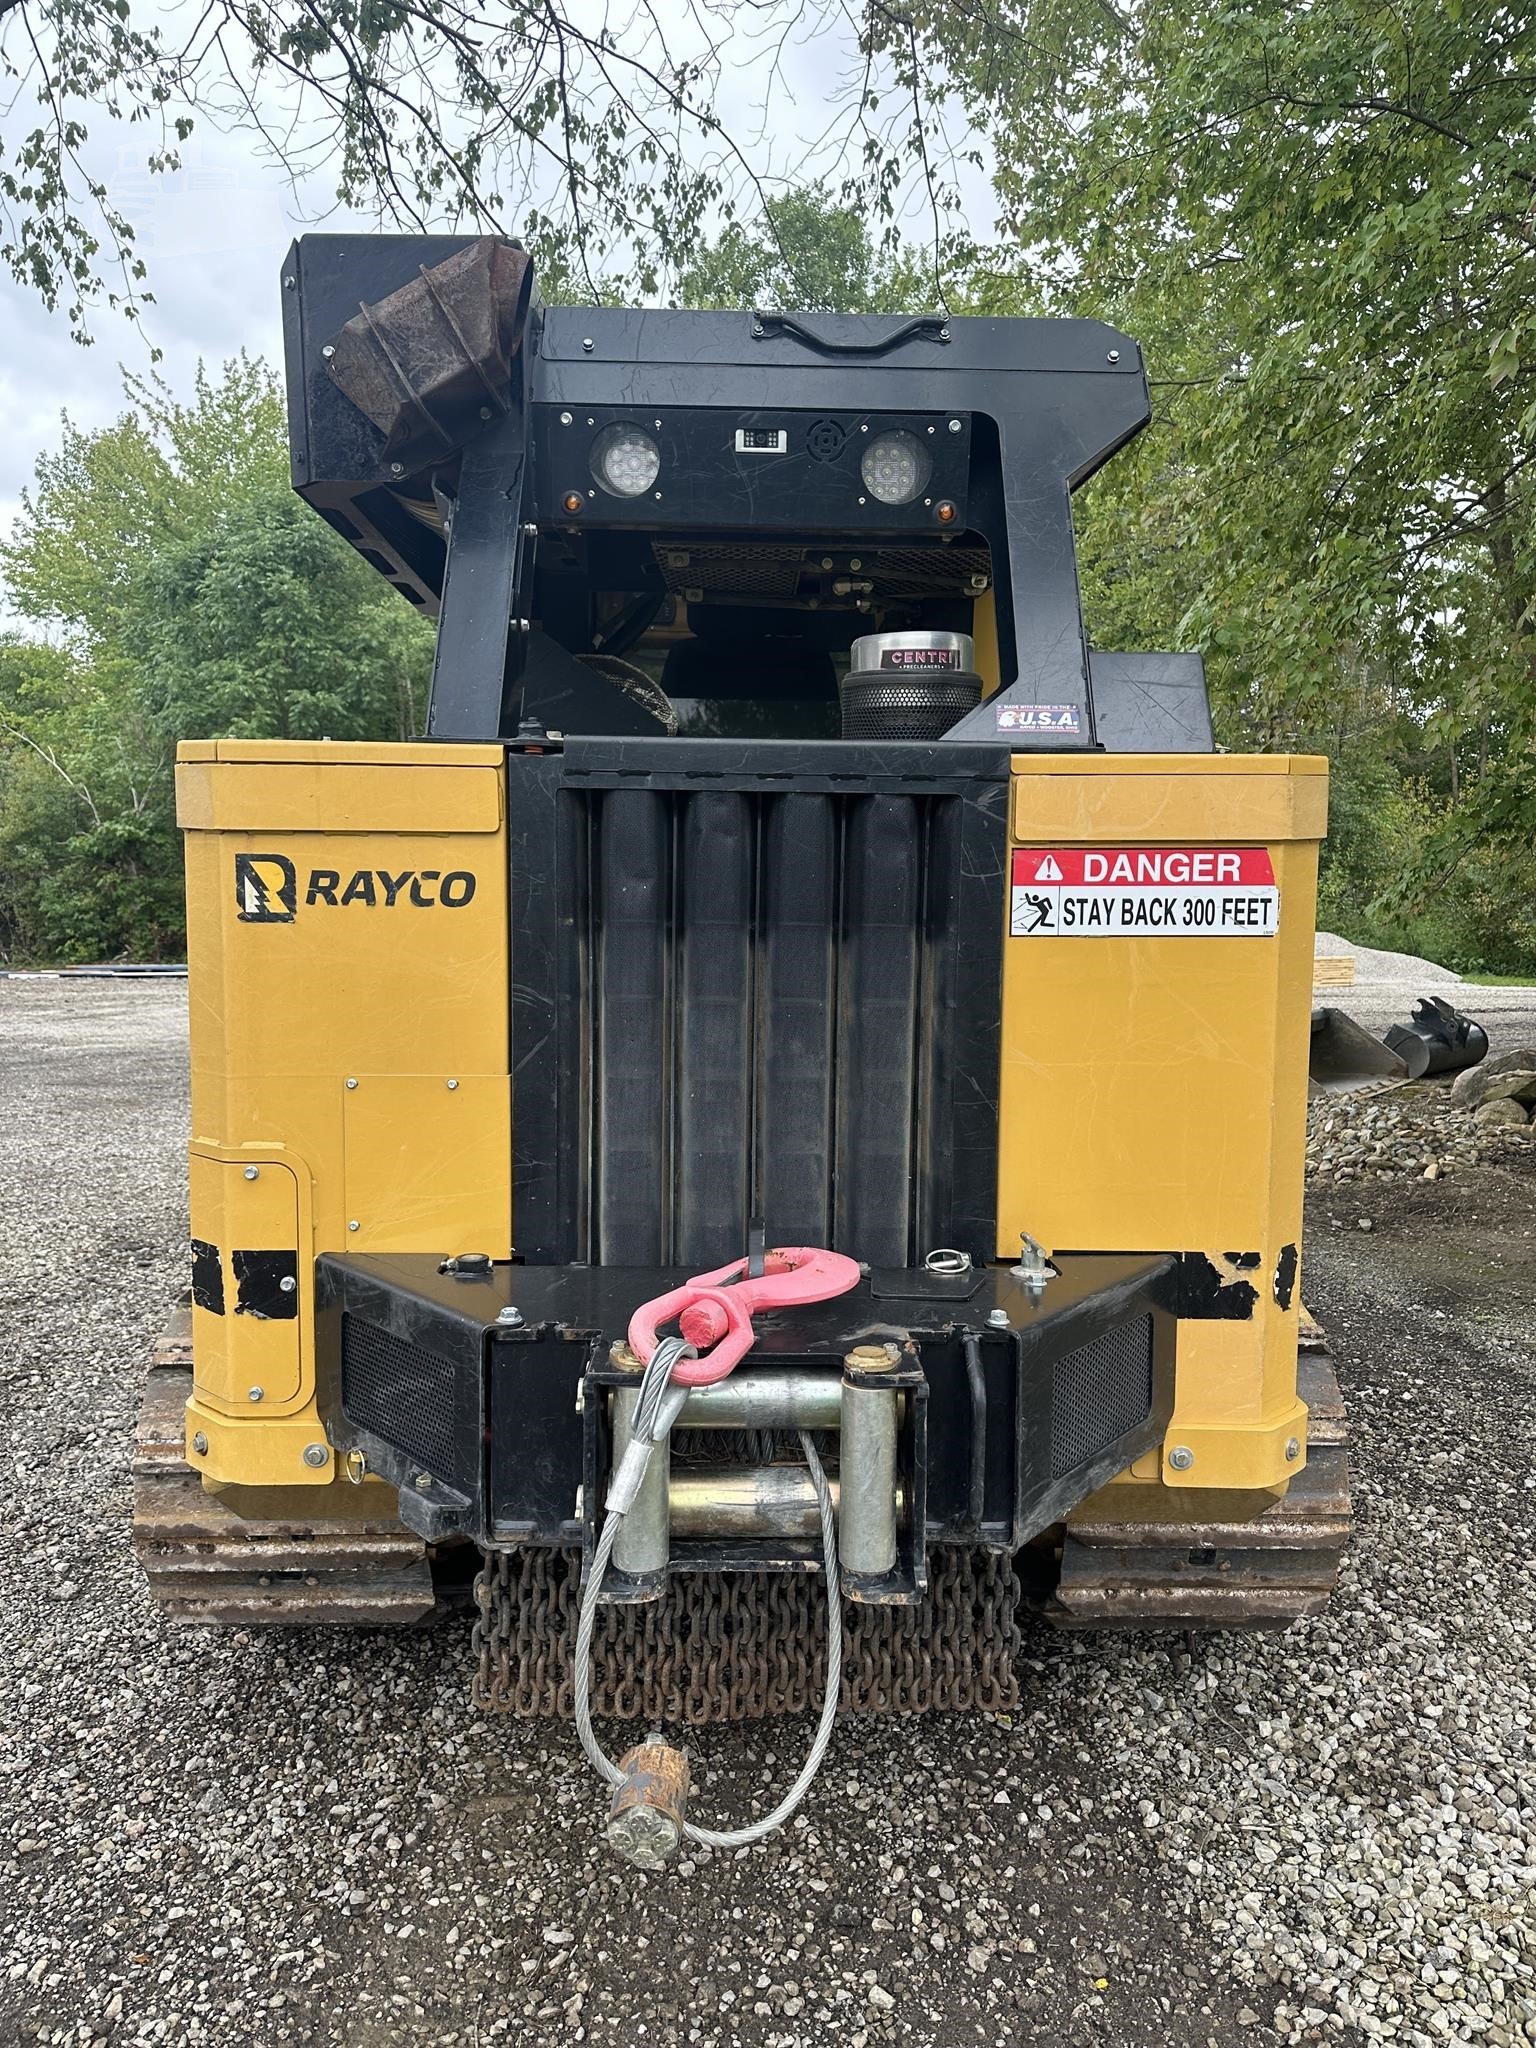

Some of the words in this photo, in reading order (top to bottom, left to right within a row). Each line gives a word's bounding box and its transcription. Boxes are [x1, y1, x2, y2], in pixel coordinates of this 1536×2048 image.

[891, 651, 953, 664] CENTRI
[1019, 711, 1078, 726] U.S.A.
[1083, 853, 1242, 883] DANGER
[305, 869, 477, 908] RAYCO
[1063, 897, 1115, 926] STAY
[1121, 897, 1177, 926] BACK
[1183, 897, 1215, 926] 300
[1222, 897, 1273, 926] FEET
